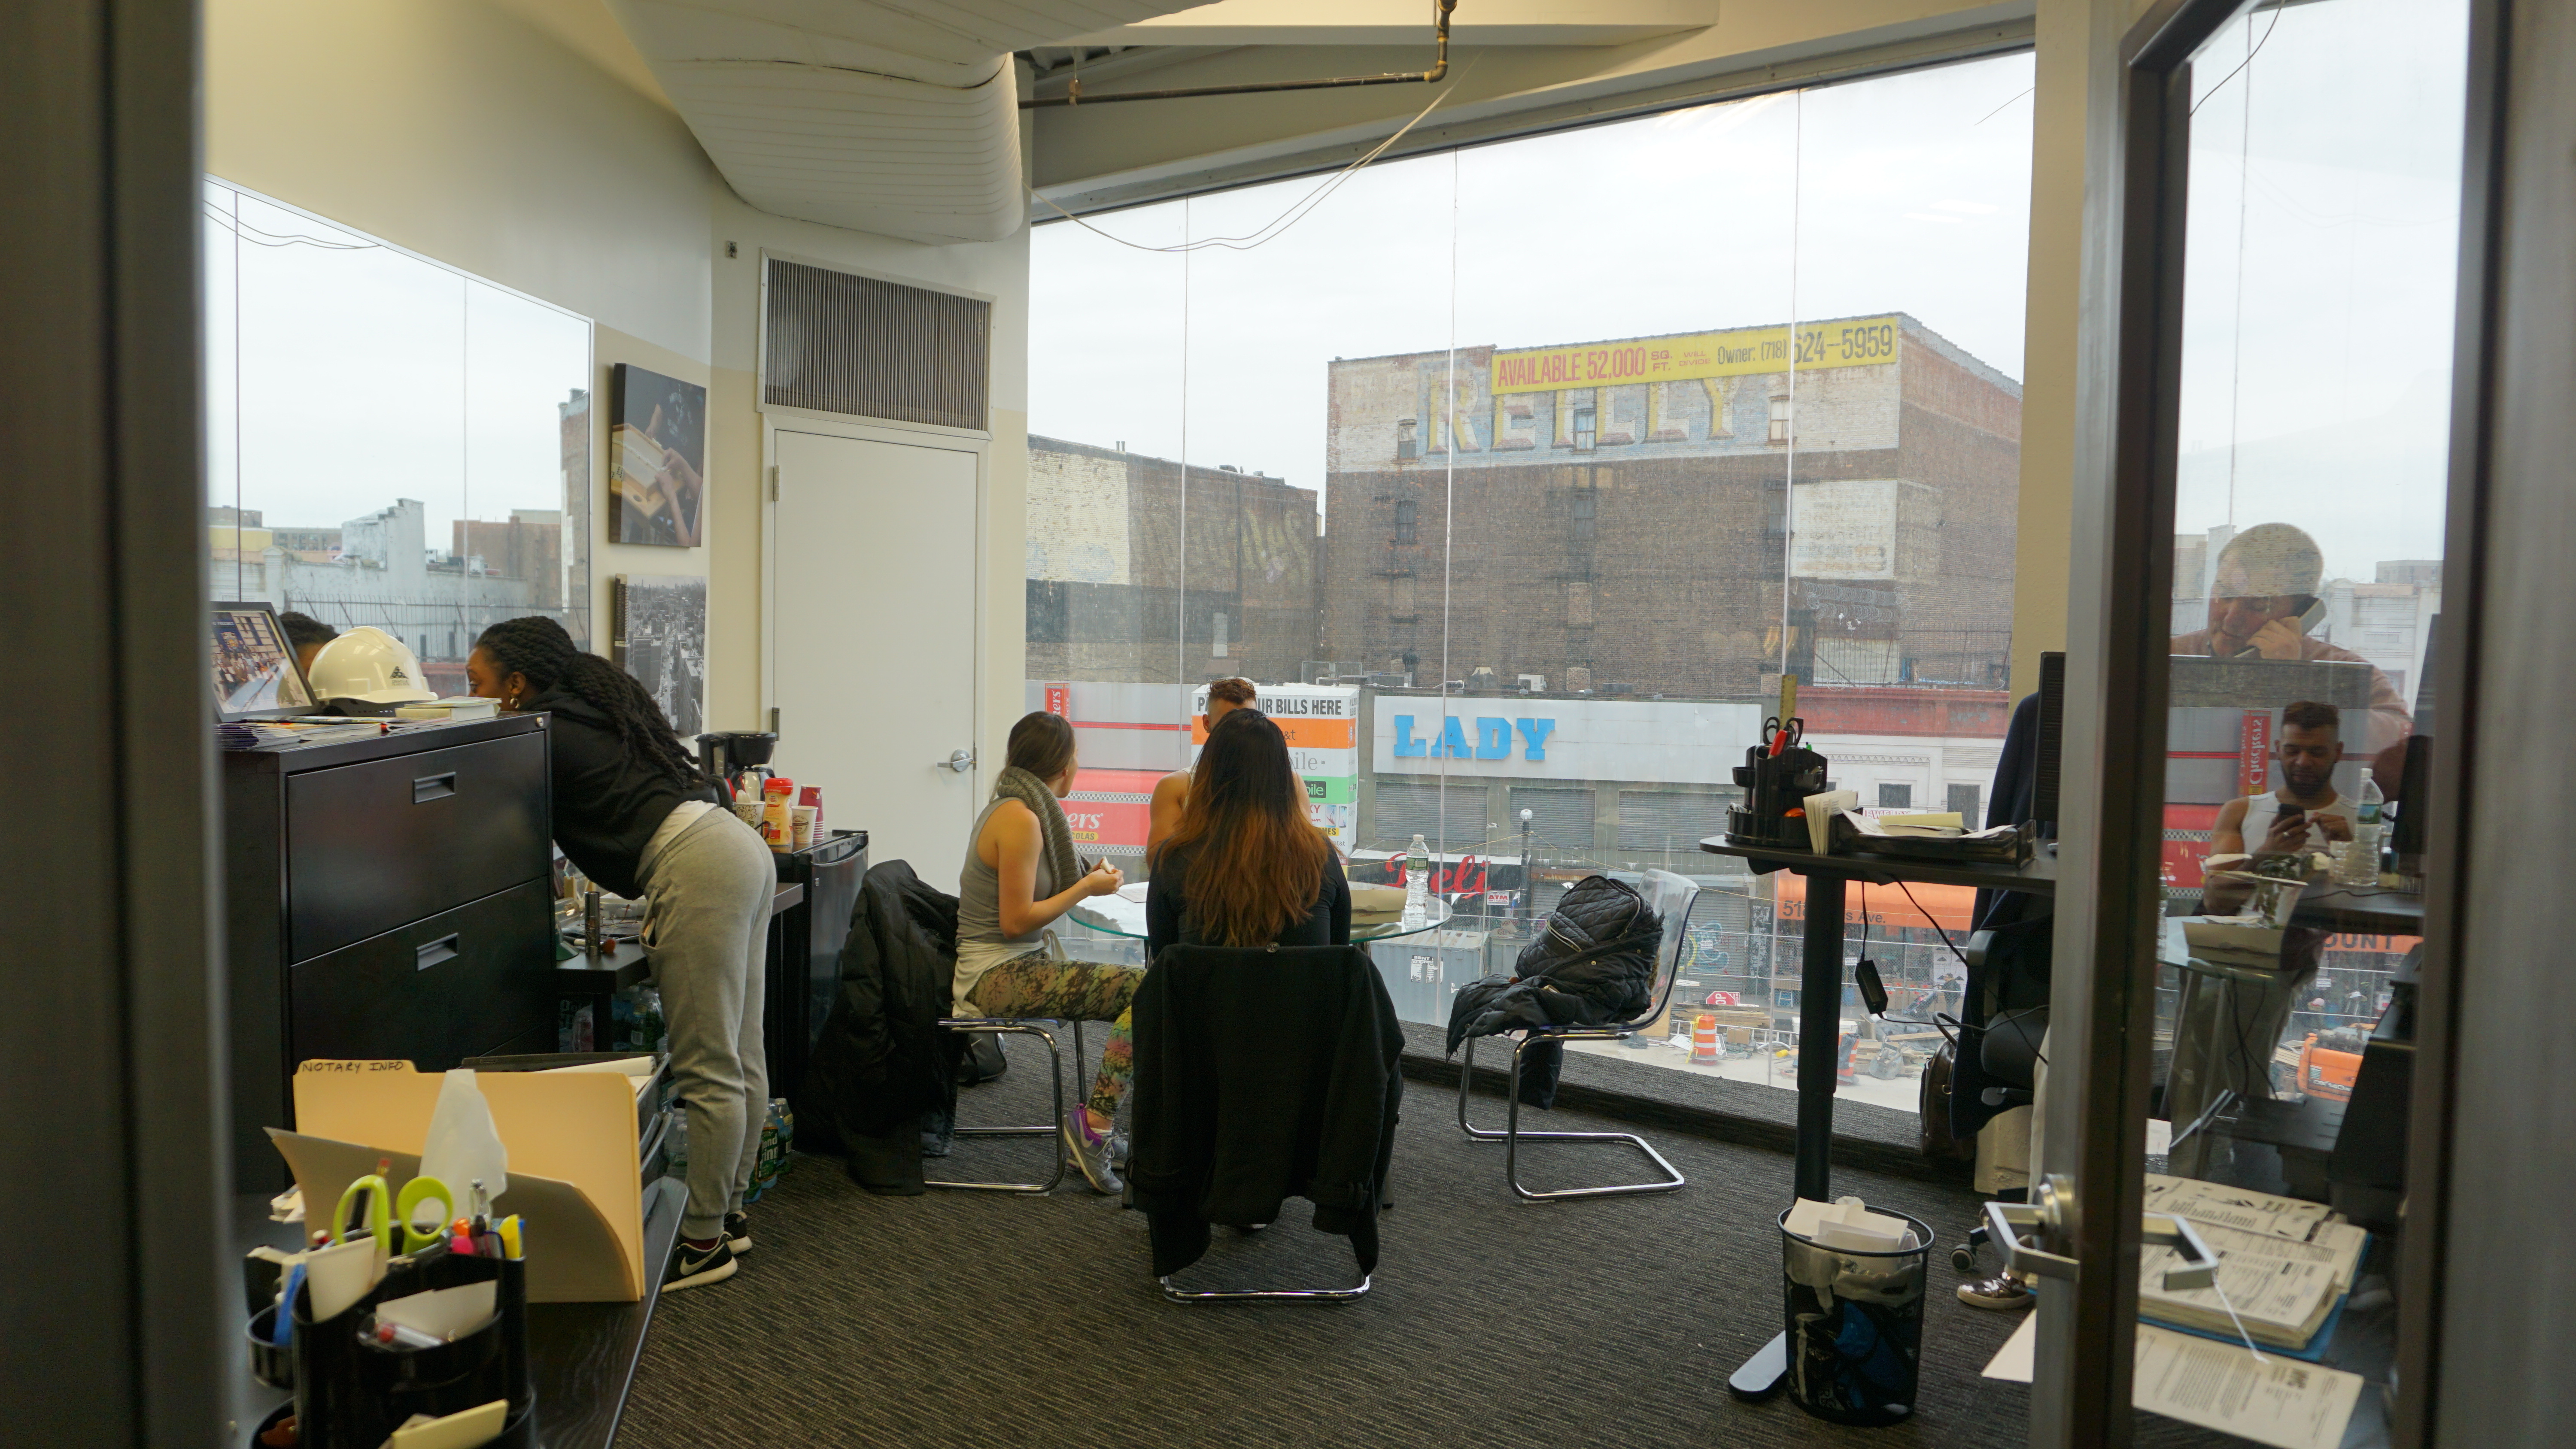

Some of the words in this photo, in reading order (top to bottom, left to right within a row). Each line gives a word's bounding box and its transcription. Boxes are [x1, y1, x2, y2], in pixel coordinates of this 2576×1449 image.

[1651, 349, 1673, 361] SQ.
[1718, 346, 1756, 365] Owner:
[1761, 338, 1787, 362] (718)
[1498, 352, 1581, 387] AVAILABLE
[1587, 346, 1646, 380] 52,000
[1653, 361, 1671, 372] FT.
[1679, 358, 1711, 367] DIVIDE
[1258, 698, 1273, 713] UR
[1276, 698, 1307, 715] BILLS
[1312, 699, 1342, 715] HERE
[1394, 715, 1555, 761] LADY
[1293, 752, 1318, 770] ile
[1066, 813, 1100, 829] ers
[1783, 900, 1805, 917] 51
[1858, 911, 1886, 923] Ave.
[1715, 993, 1726, 1005] OP
[302, 1061, 361, 1074] NOTARY
[368, 1061, 404, 1071] INFO
